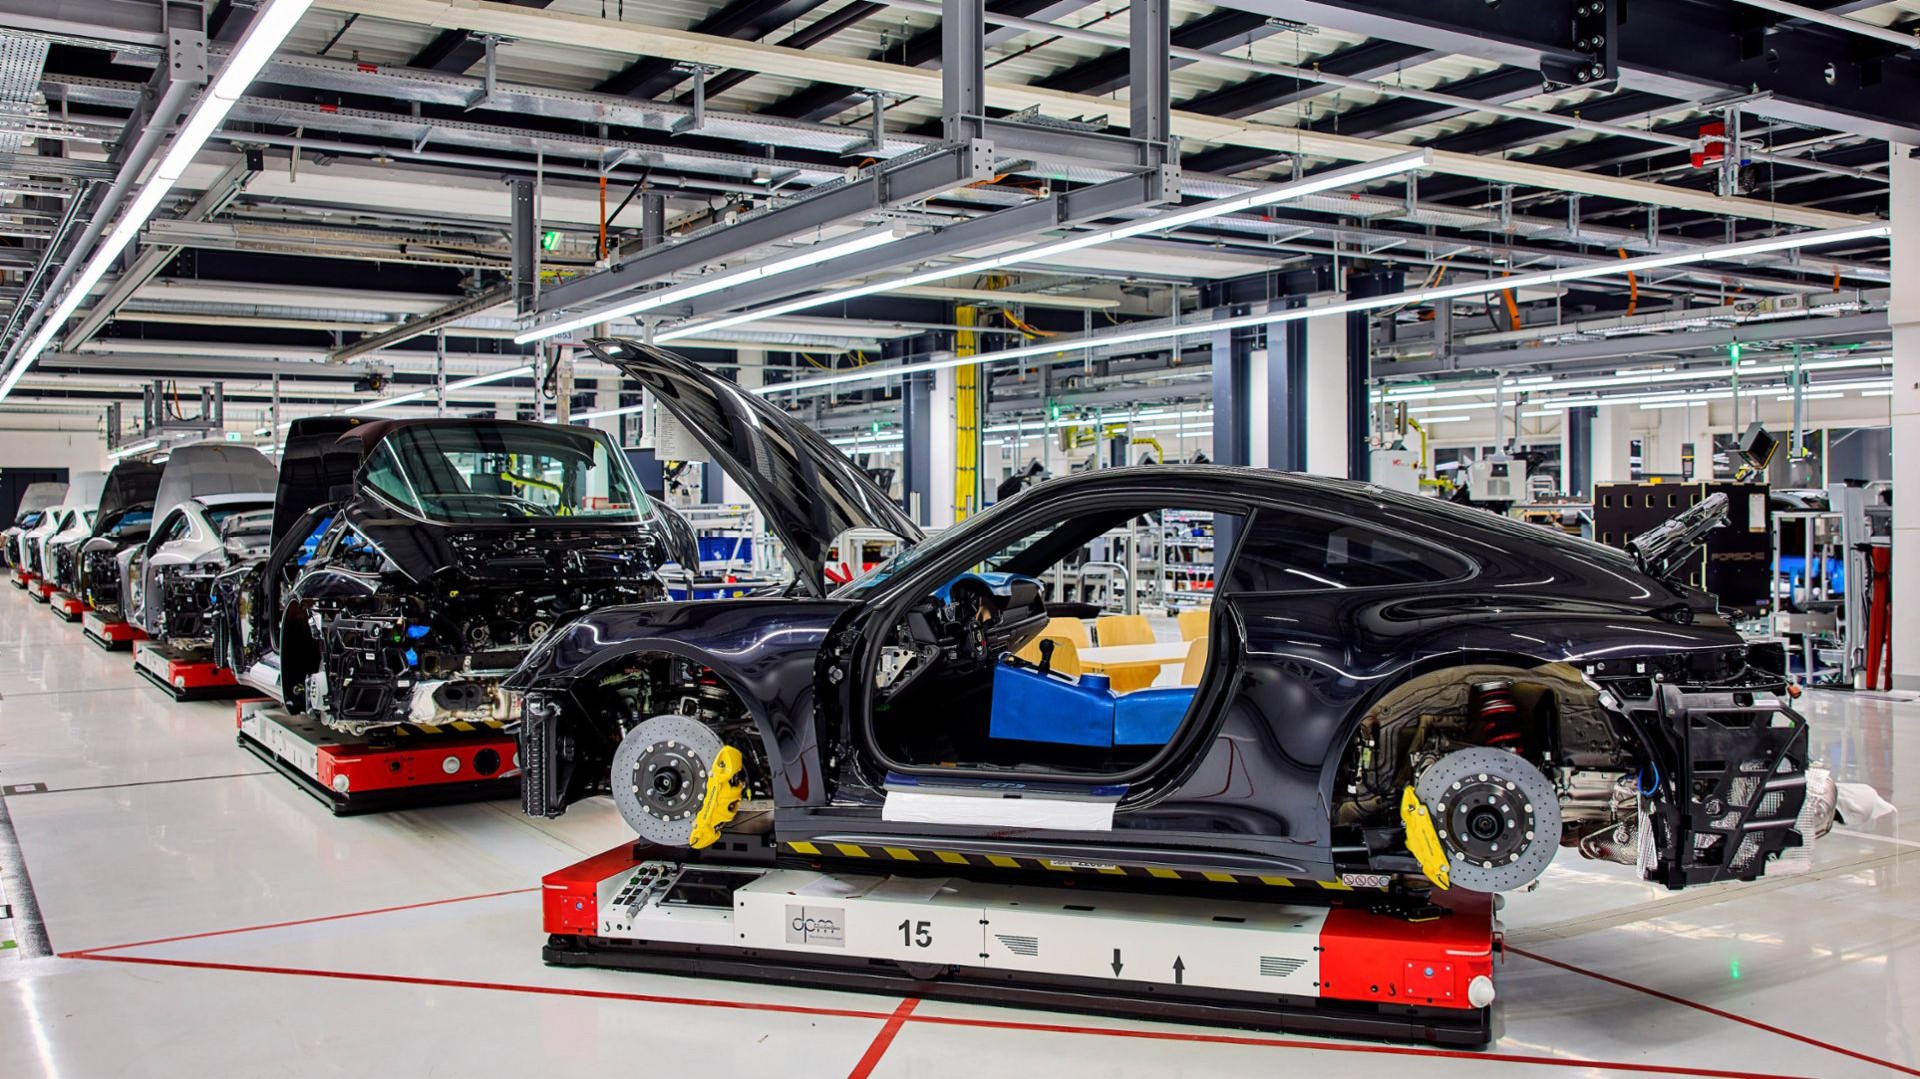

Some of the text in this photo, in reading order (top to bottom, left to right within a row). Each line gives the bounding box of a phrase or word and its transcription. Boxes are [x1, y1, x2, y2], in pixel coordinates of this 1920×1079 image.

[1711, 552, 1765, 561] PORSCHE
[792, 906, 834, 943] dpm
[898, 919, 933, 948] 15
